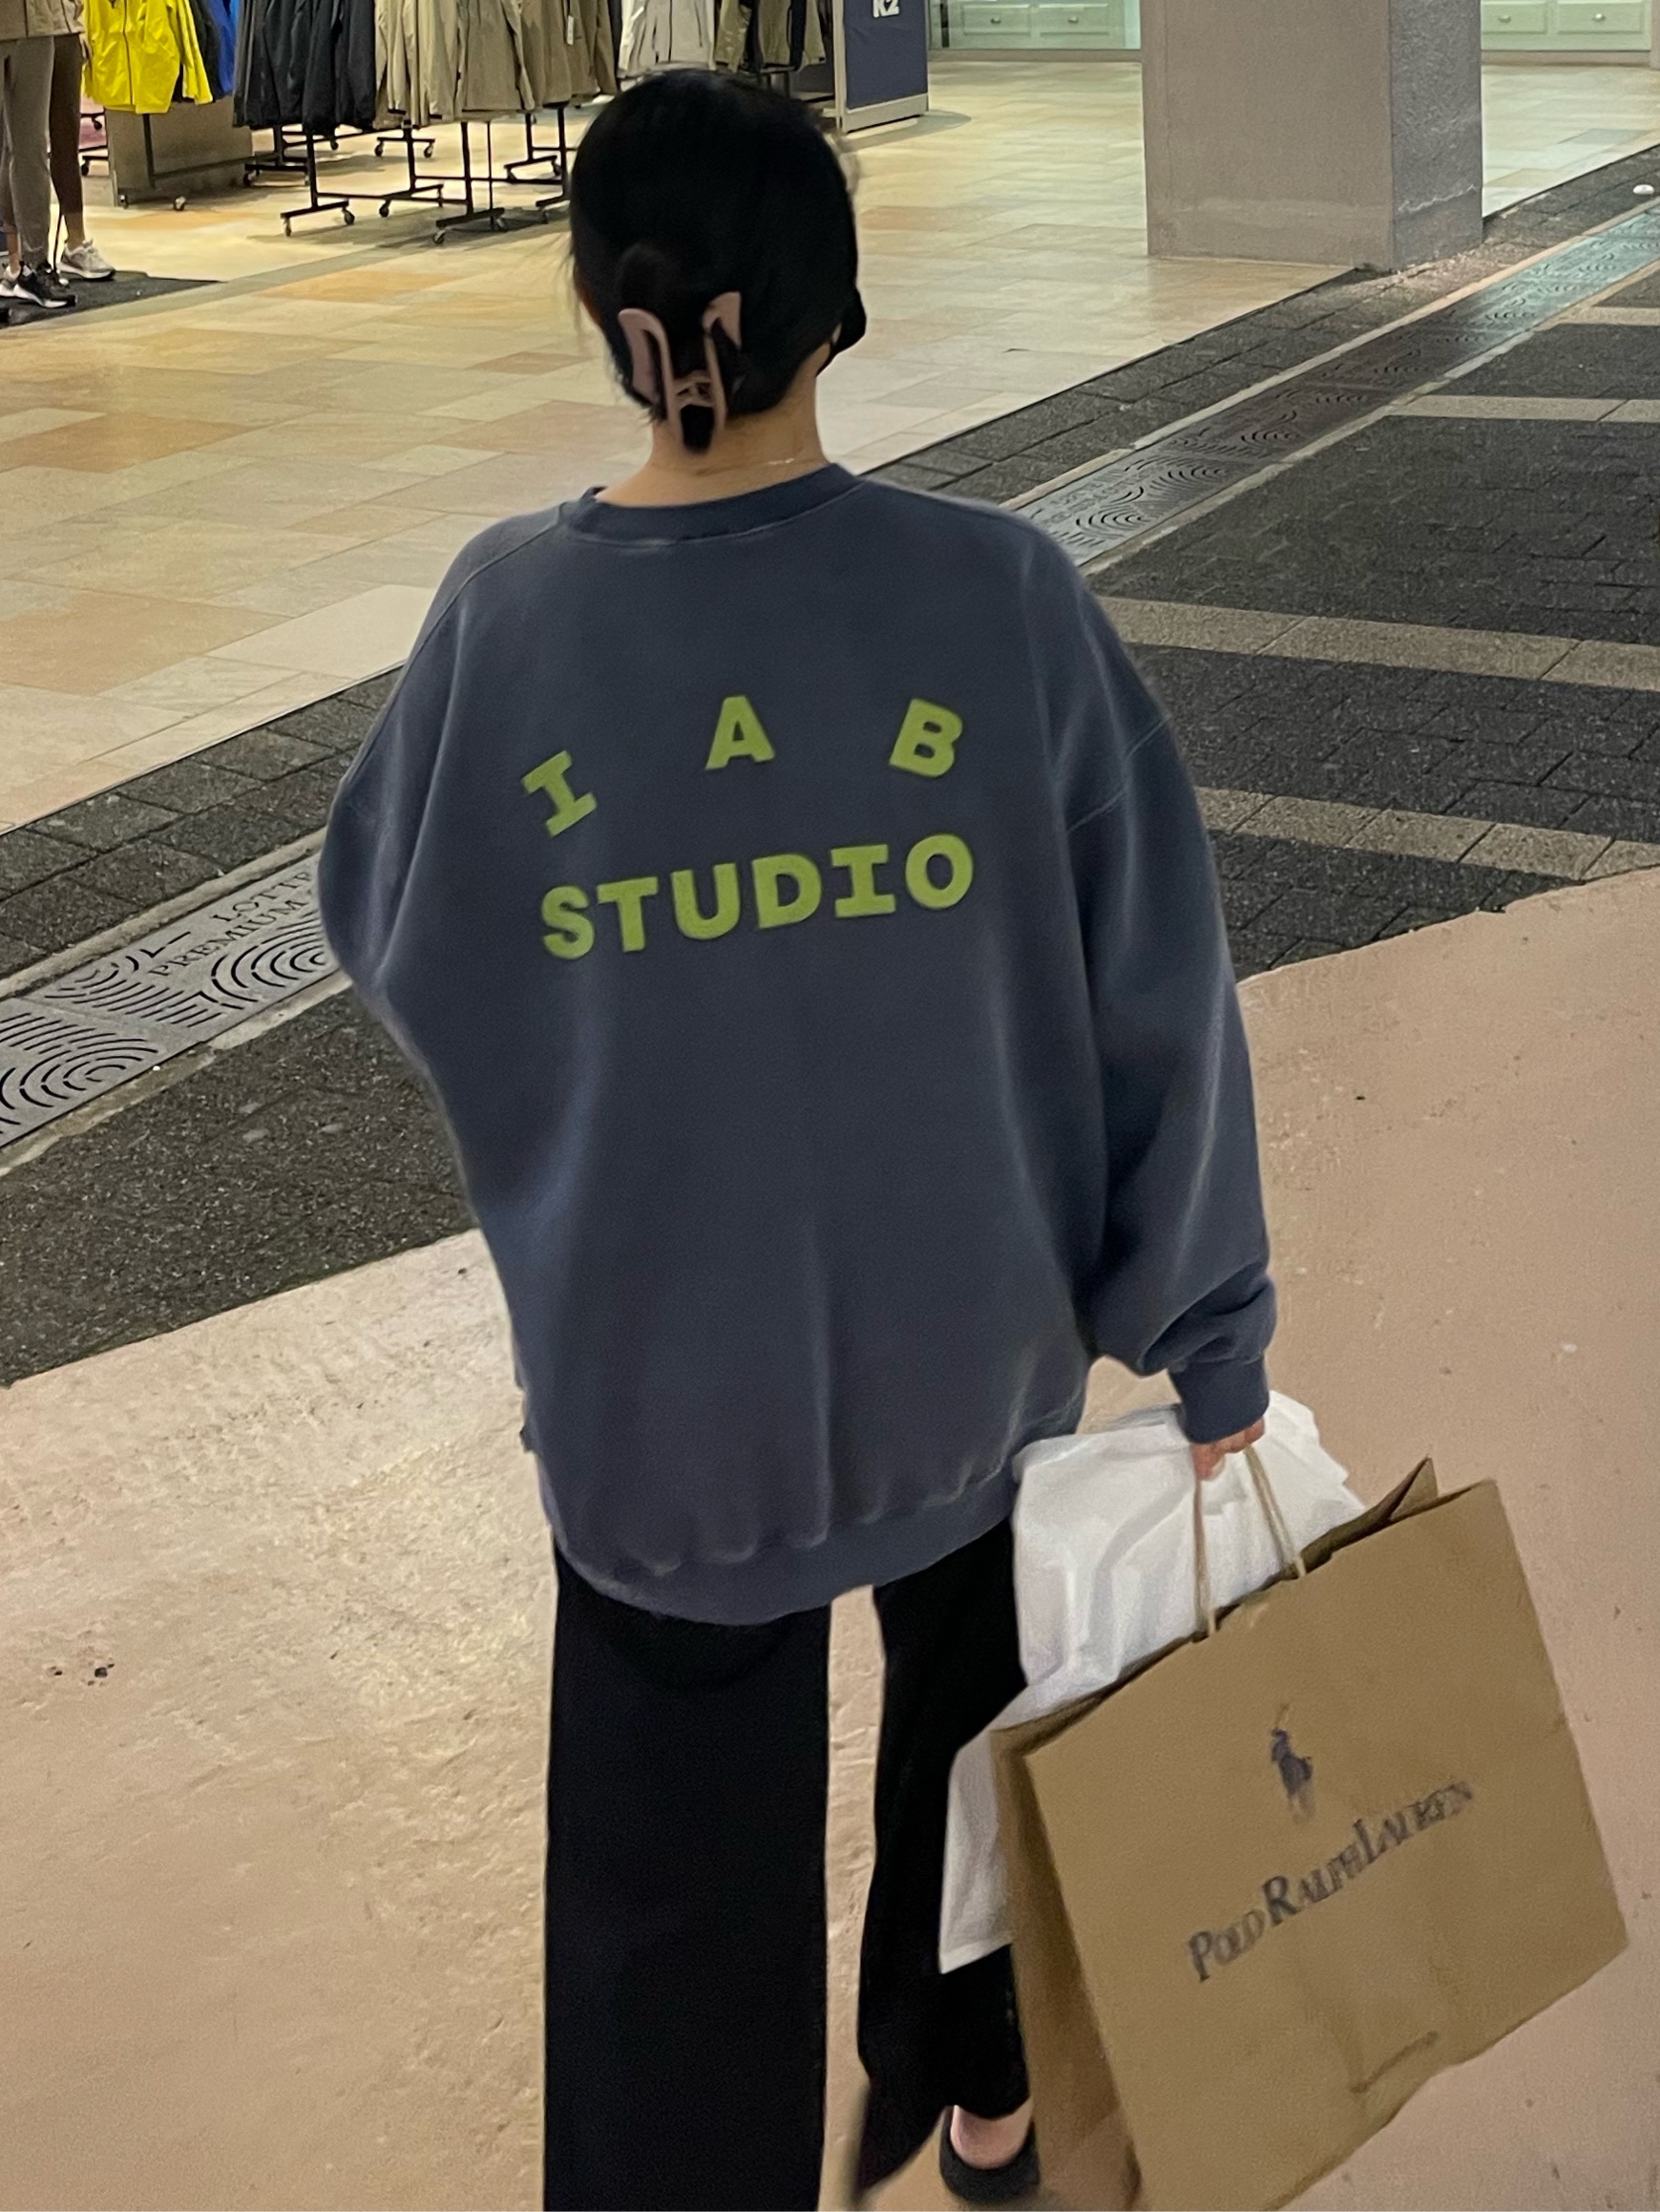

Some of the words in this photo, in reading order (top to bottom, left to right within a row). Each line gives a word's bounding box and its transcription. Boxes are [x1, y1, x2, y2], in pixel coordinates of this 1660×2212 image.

[872, 0, 900, 18] K2
[521, 750, 597, 837] I
[704, 695, 775, 769] A
[889, 698, 963, 778] B
[148, 898, 310, 978] PREMIUM
[541, 833, 974, 959] STUDIO
